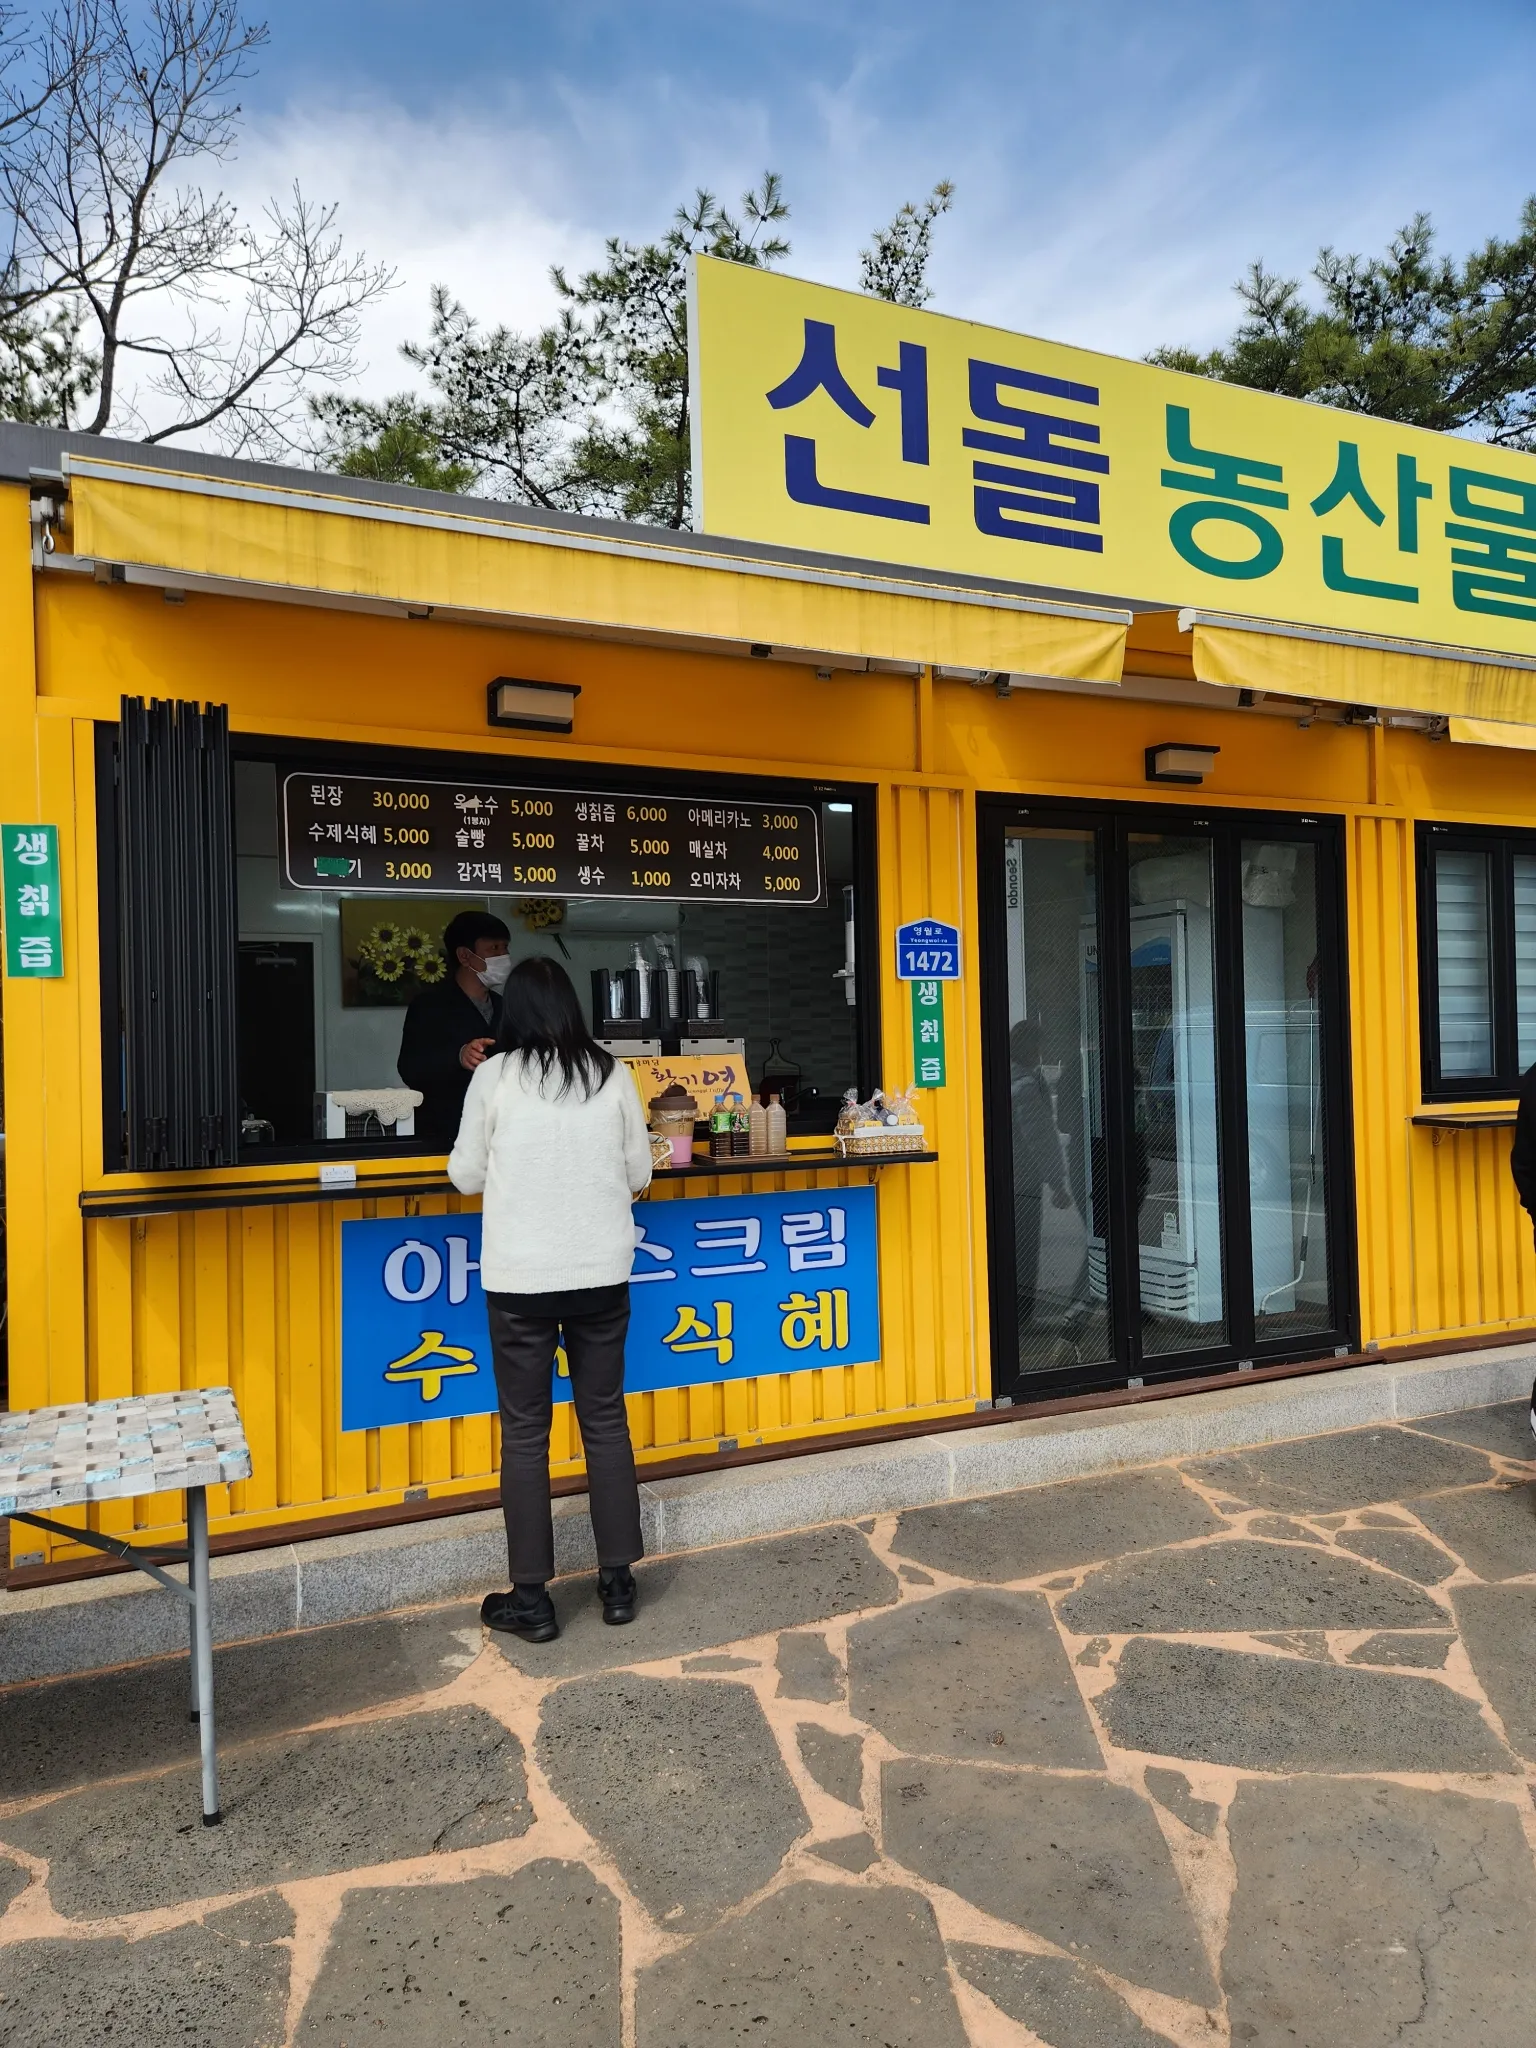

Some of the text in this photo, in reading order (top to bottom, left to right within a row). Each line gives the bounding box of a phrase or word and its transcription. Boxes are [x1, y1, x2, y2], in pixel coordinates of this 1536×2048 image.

[766, 319, 1536, 622] 선돌 농산물
[310, 784, 430, 811] 된장 30,000
[510, 799, 553, 817] 5,000
[463, 815, 490, 827] (1봉지)
[575, 802, 667, 823] 생칡즙 6,000
[688, 807, 798, 831] 아메리카노 3,000
[308, 822, 429, 846] 수제식혜 5,000
[455, 828, 555, 850] 술빵 5,000
[576, 833, 670, 856] 꿀차 5,000
[689, 840, 799, 861] 매실차 4,000
[385, 861, 432, 880] 3,000
[457, 862, 557, 884] 감자떡 5,000
[577, 865, 671, 888] 생수 1,000
[690, 871, 801, 892] 오미자차 5,000
[13, 832, 53, 969] 생칡즙
[913, 926, 943, 936] 영월로
[906, 951, 953, 972] 1472
[918, 981, 941, 1082] 생칡즙
[382, 1207, 847, 1304] 아스크림
[383, 1289, 852, 1402] 수식혜
